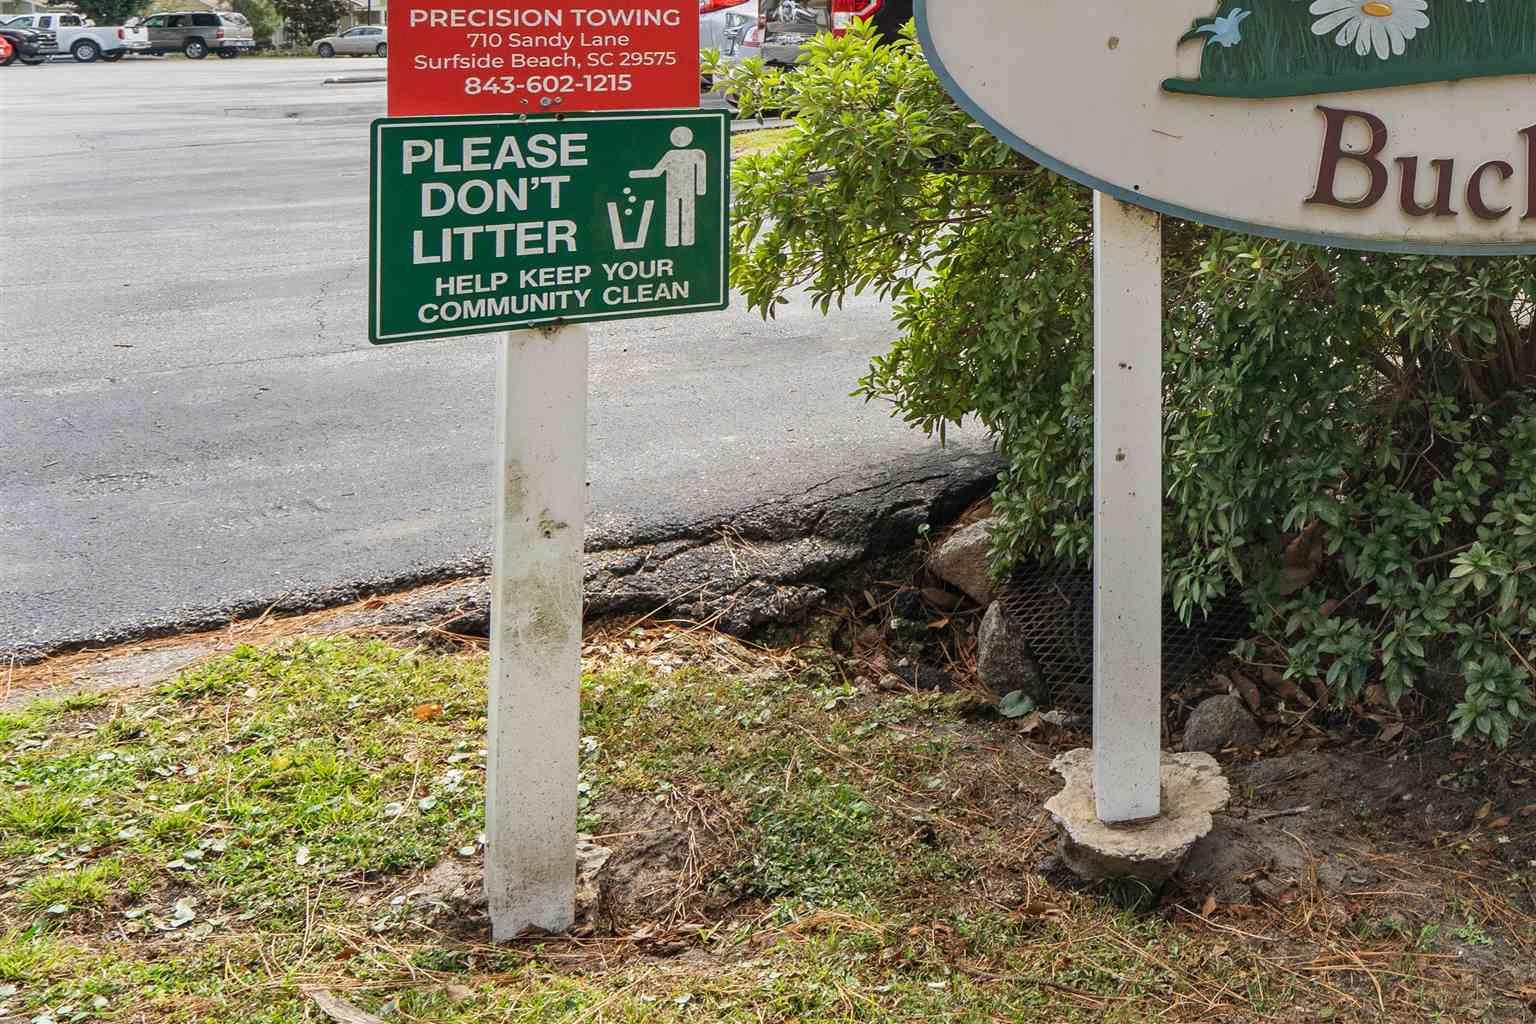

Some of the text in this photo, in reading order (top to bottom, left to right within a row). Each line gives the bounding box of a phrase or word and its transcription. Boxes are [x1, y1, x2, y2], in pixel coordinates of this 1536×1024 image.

[410, 9, 680, 28] PRECISION TOWING
[467, 32, 630, 51] 710 Sandy Lane
[414, 51, 677, 70] Surfside Beach, SC 29575
[464, 74, 632, 95] 843-602-1215
[402, 133, 588, 175] PLEASE
[421, 175, 570, 217] DON'T
[413, 219, 577, 265] LITTER
[435, 259, 674, 296] HELP KEEP YOUR
[418, 281, 689, 324] COMMUNITY CLEAN
